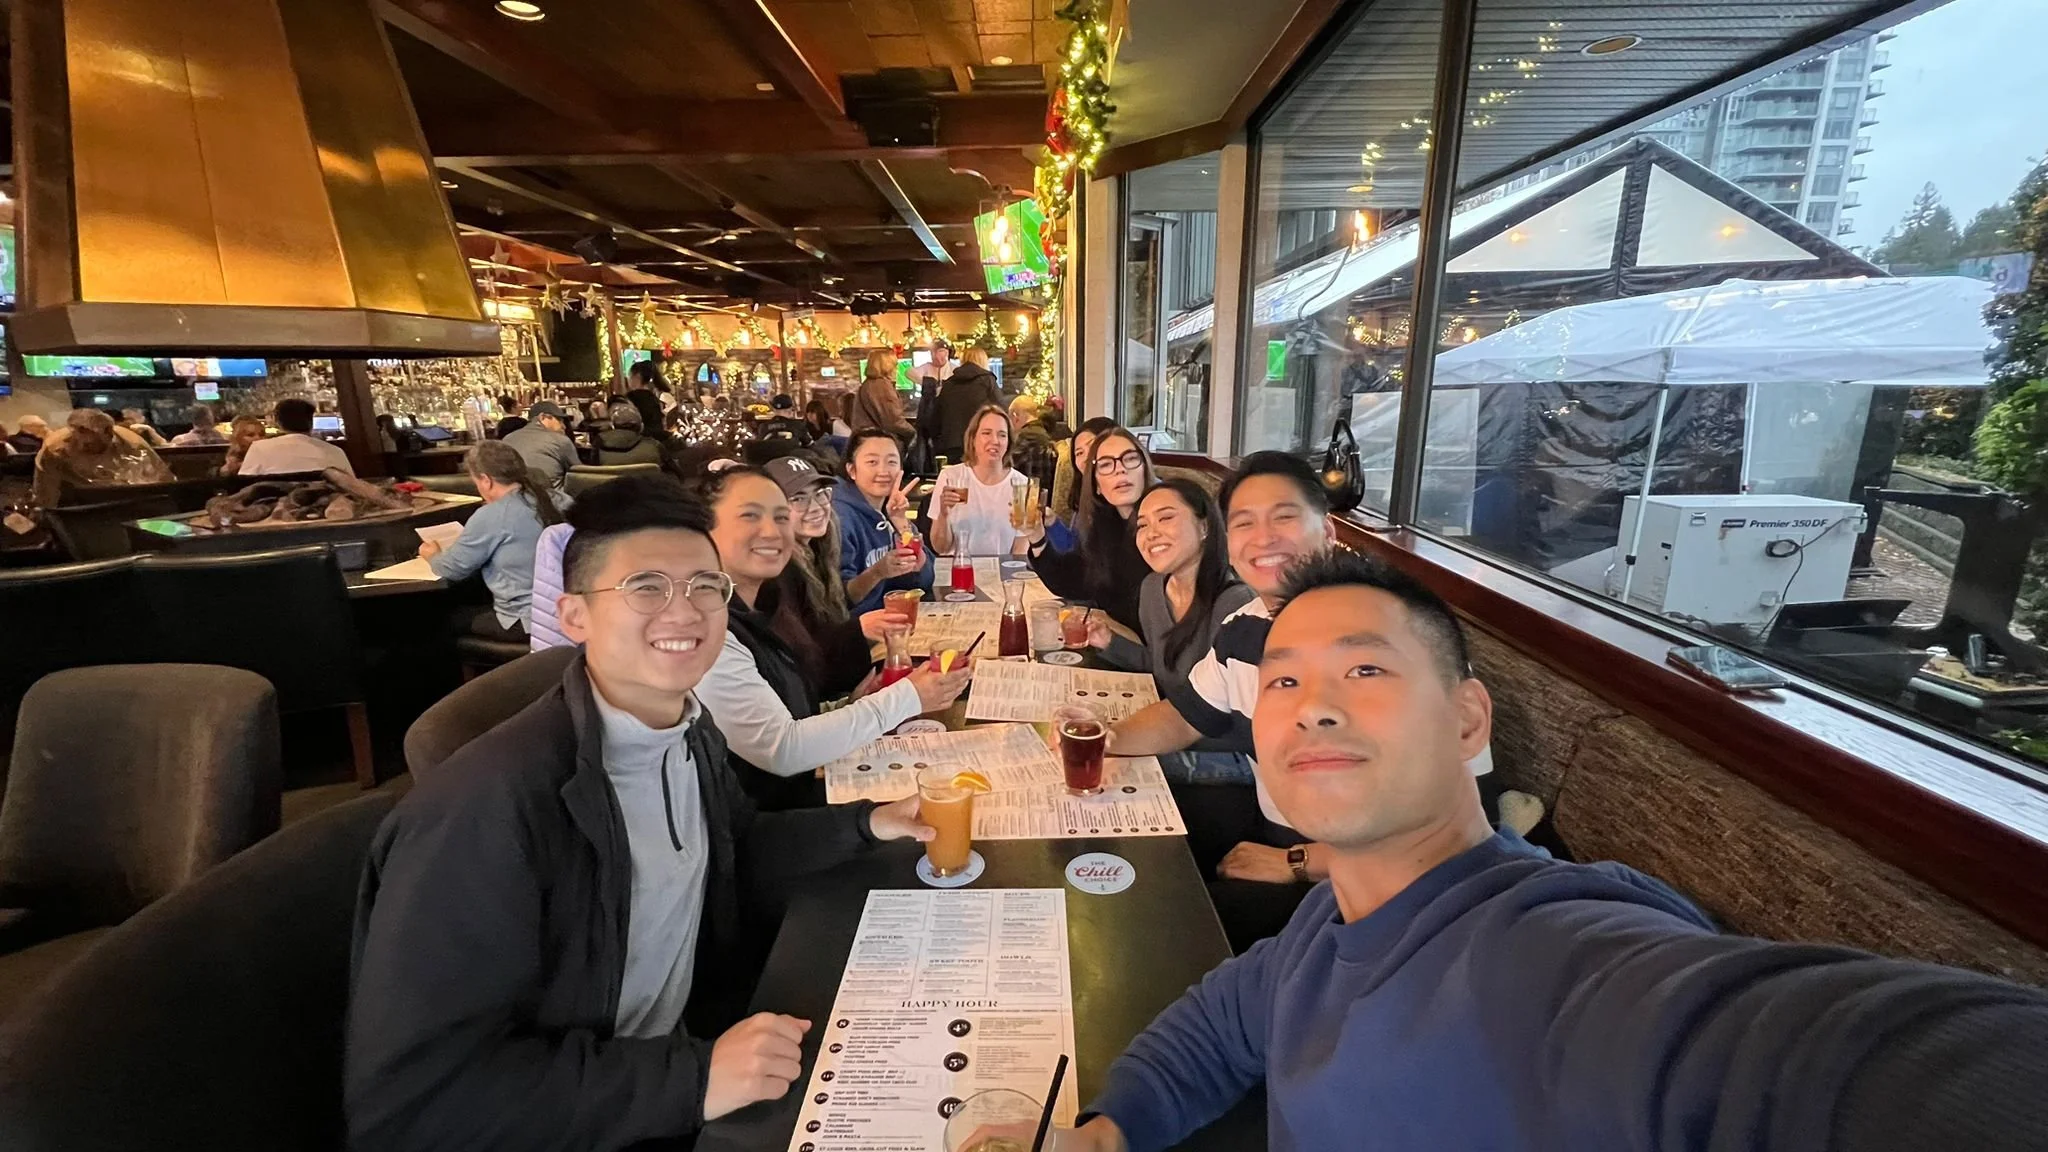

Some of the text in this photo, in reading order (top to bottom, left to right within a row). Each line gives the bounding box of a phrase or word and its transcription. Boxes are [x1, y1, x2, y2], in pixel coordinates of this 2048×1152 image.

[787, 458, 810, 472] NY
[1749, 519, 1790, 528] Premier
[1073, 865, 1124, 878] Chill
[901, 1000, 998, 1008] HAPPY HOUR
